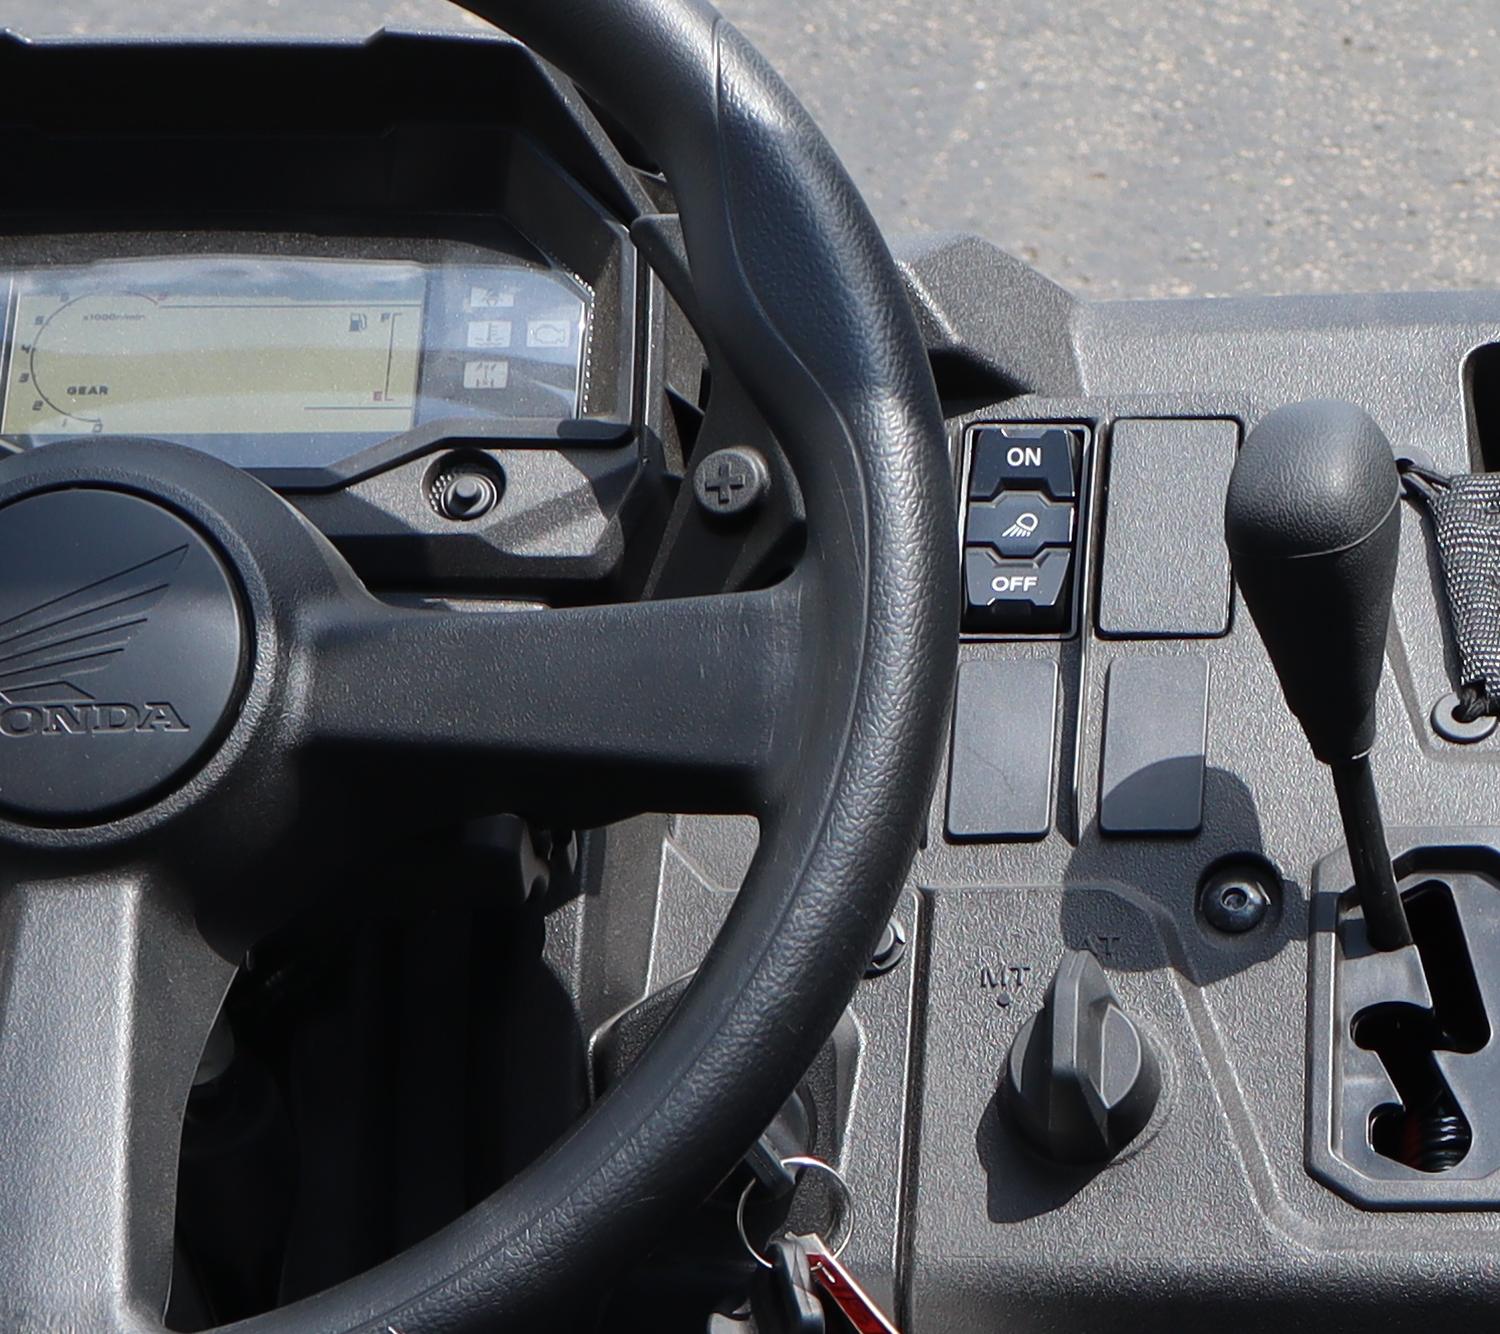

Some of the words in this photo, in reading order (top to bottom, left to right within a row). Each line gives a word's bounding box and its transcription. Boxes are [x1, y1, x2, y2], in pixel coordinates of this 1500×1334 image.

[66, 385, 109, 396] GEAR
[31, 400, 44, 411] 2
[1006, 446, 1042, 467] ON
[990, 575, 1038, 593] OFF
[979, 965, 1032, 989] MT
